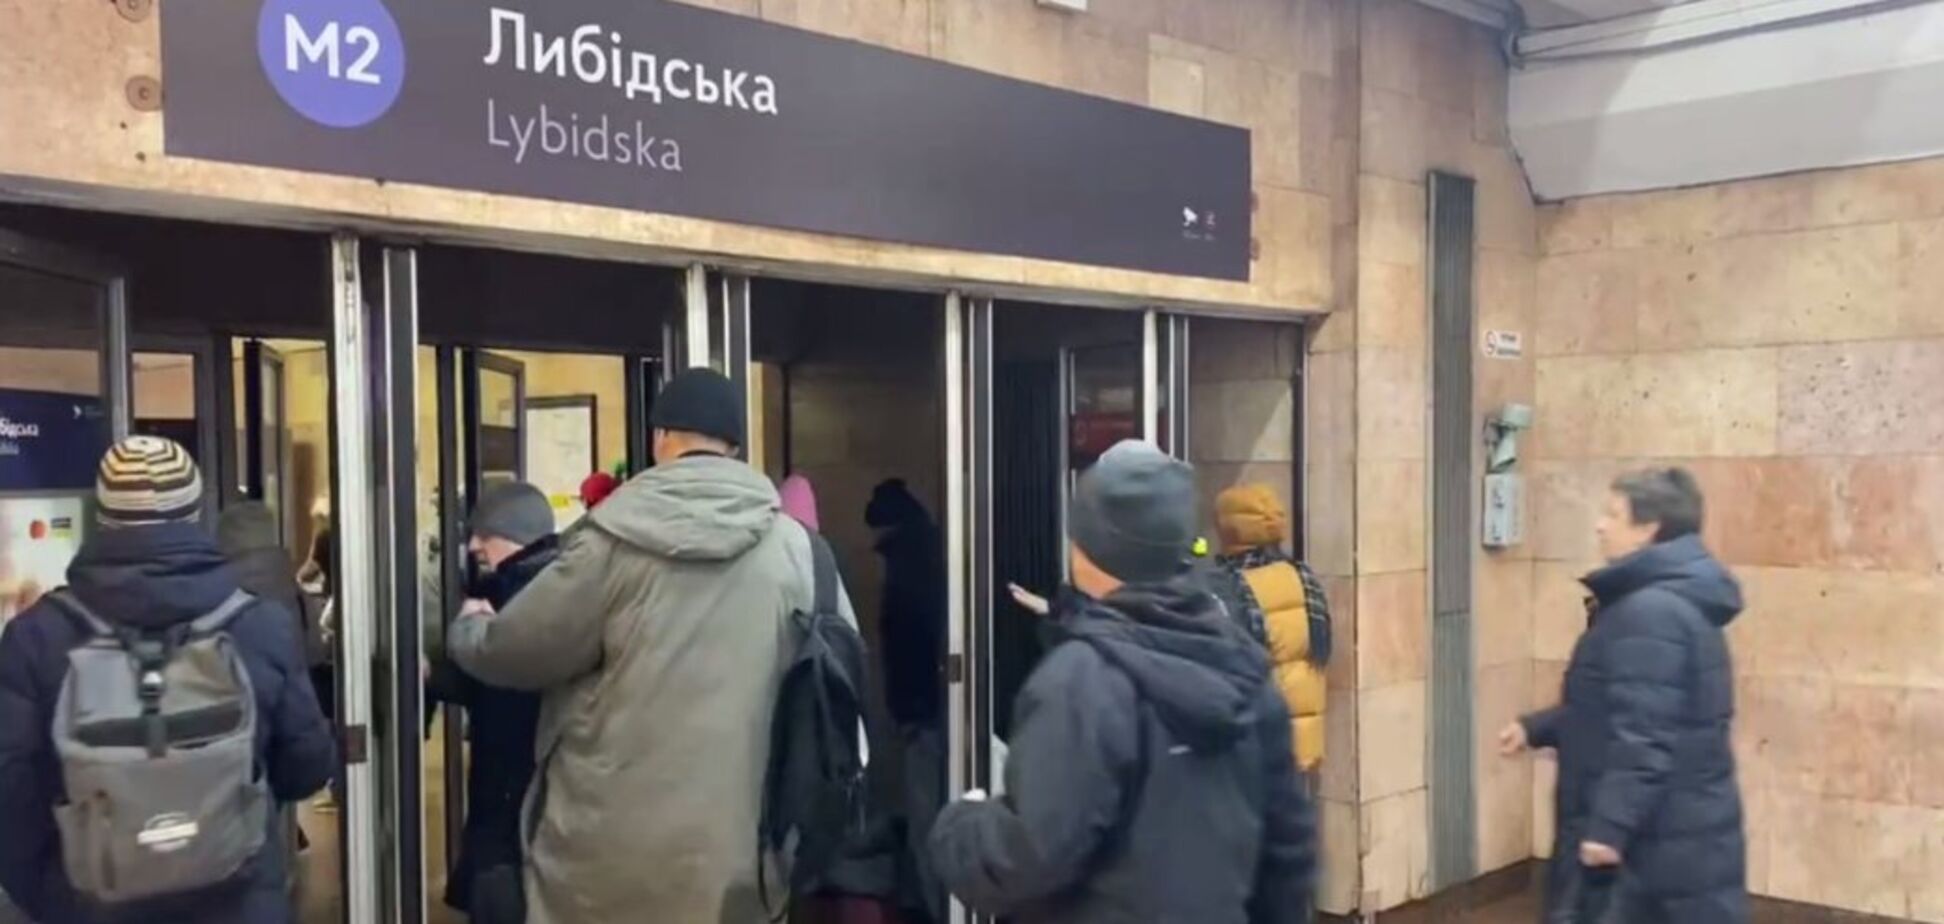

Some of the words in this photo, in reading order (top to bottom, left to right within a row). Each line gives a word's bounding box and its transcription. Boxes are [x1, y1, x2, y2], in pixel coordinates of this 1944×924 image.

[285, 13, 381, 85] M2
[483, 7, 779, 115] Либідська
[488, 98, 683, 172] Lybidska
